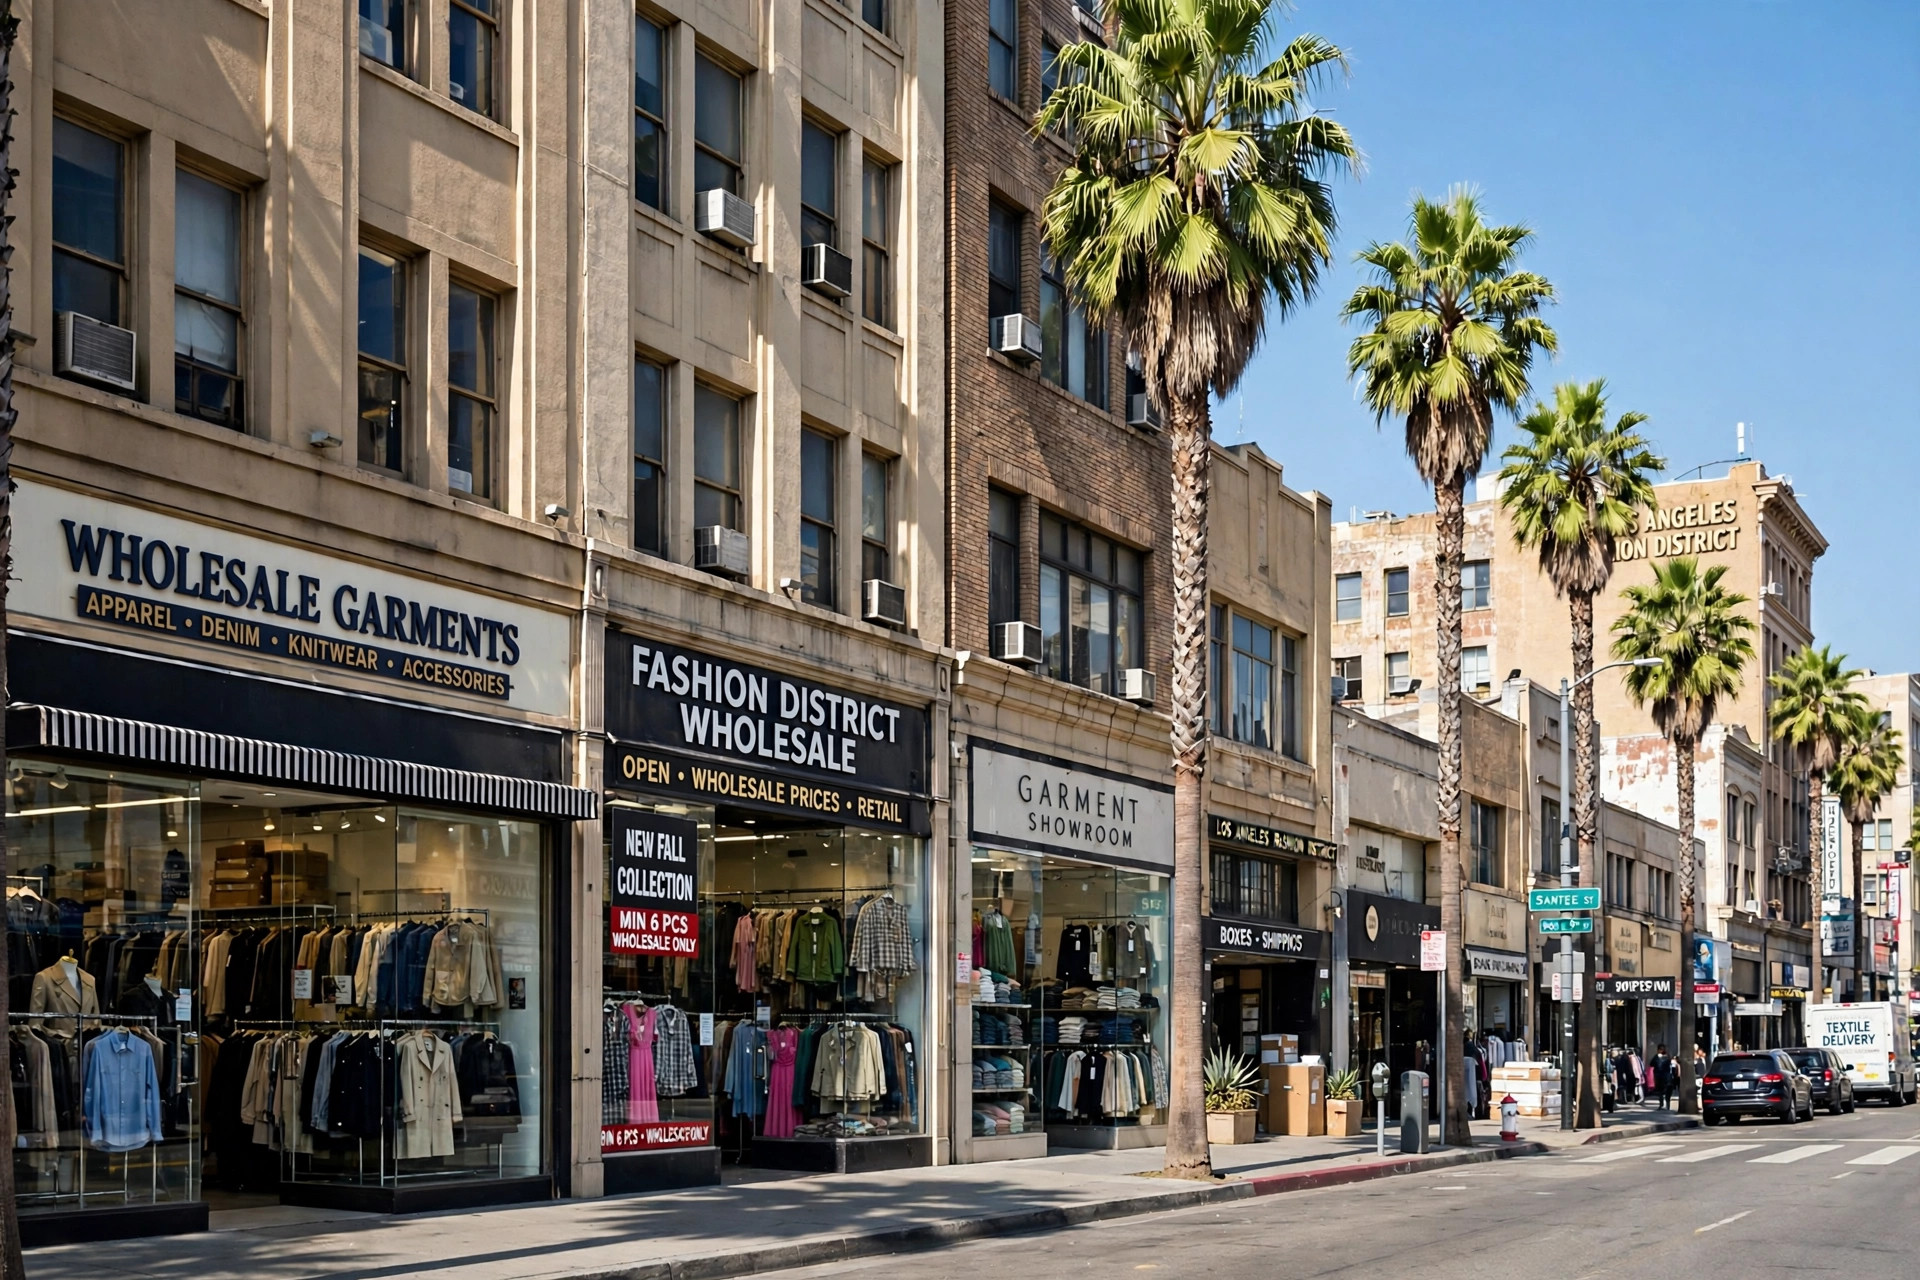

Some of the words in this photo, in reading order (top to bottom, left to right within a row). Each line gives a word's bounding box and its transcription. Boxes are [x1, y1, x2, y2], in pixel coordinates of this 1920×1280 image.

[1644, 499, 1737, 533] ANGELES
[1654, 526, 1740, 558] DISTRICT
[61, 518, 321, 624] WHOLESALE
[333, 584, 521, 666] GARMENTS
[86, 592, 177, 631] APPAREL
[202, 615, 260, 648] DENIM
[288, 633, 378, 671] KNITWEAR
[402, 658, 505, 696] ACCESSORIES
[631, 644, 768, 715] FASHION
[780, 680, 900, 743] DISTRICT
[680, 702, 857, 775] WHOLESALE
[622, 754, 670, 784] OPEN
[691, 766, 785, 805] WHOLESALE
[790, 785, 840, 814] PRICES
[858, 797, 903, 823] RETAIL
[1018, 774, 1139, 824] GARMENT
[625, 828, 654, 857] NEW
[657, 834, 686, 863] FALL
[1028, 812, 1133, 848] SHOWROOM
[617, 866, 693, 902] COLLECTION
[1535, 895, 1579, 906] SANTEE
[1583, 895, 1594, 905] ST
[619, 911, 647, 930] MIN
[650, 914, 659, 930] 6
[662, 915, 689, 935] PCS
[1220, 925, 1253, 947] BOXES
[612, 932, 670, 951] WHOLESALE
[672, 936, 697, 954] ONLY
[1823, 1034, 1876, 1046] DELIVERY
[1826, 1021, 1871, 1033] TEXTILE
